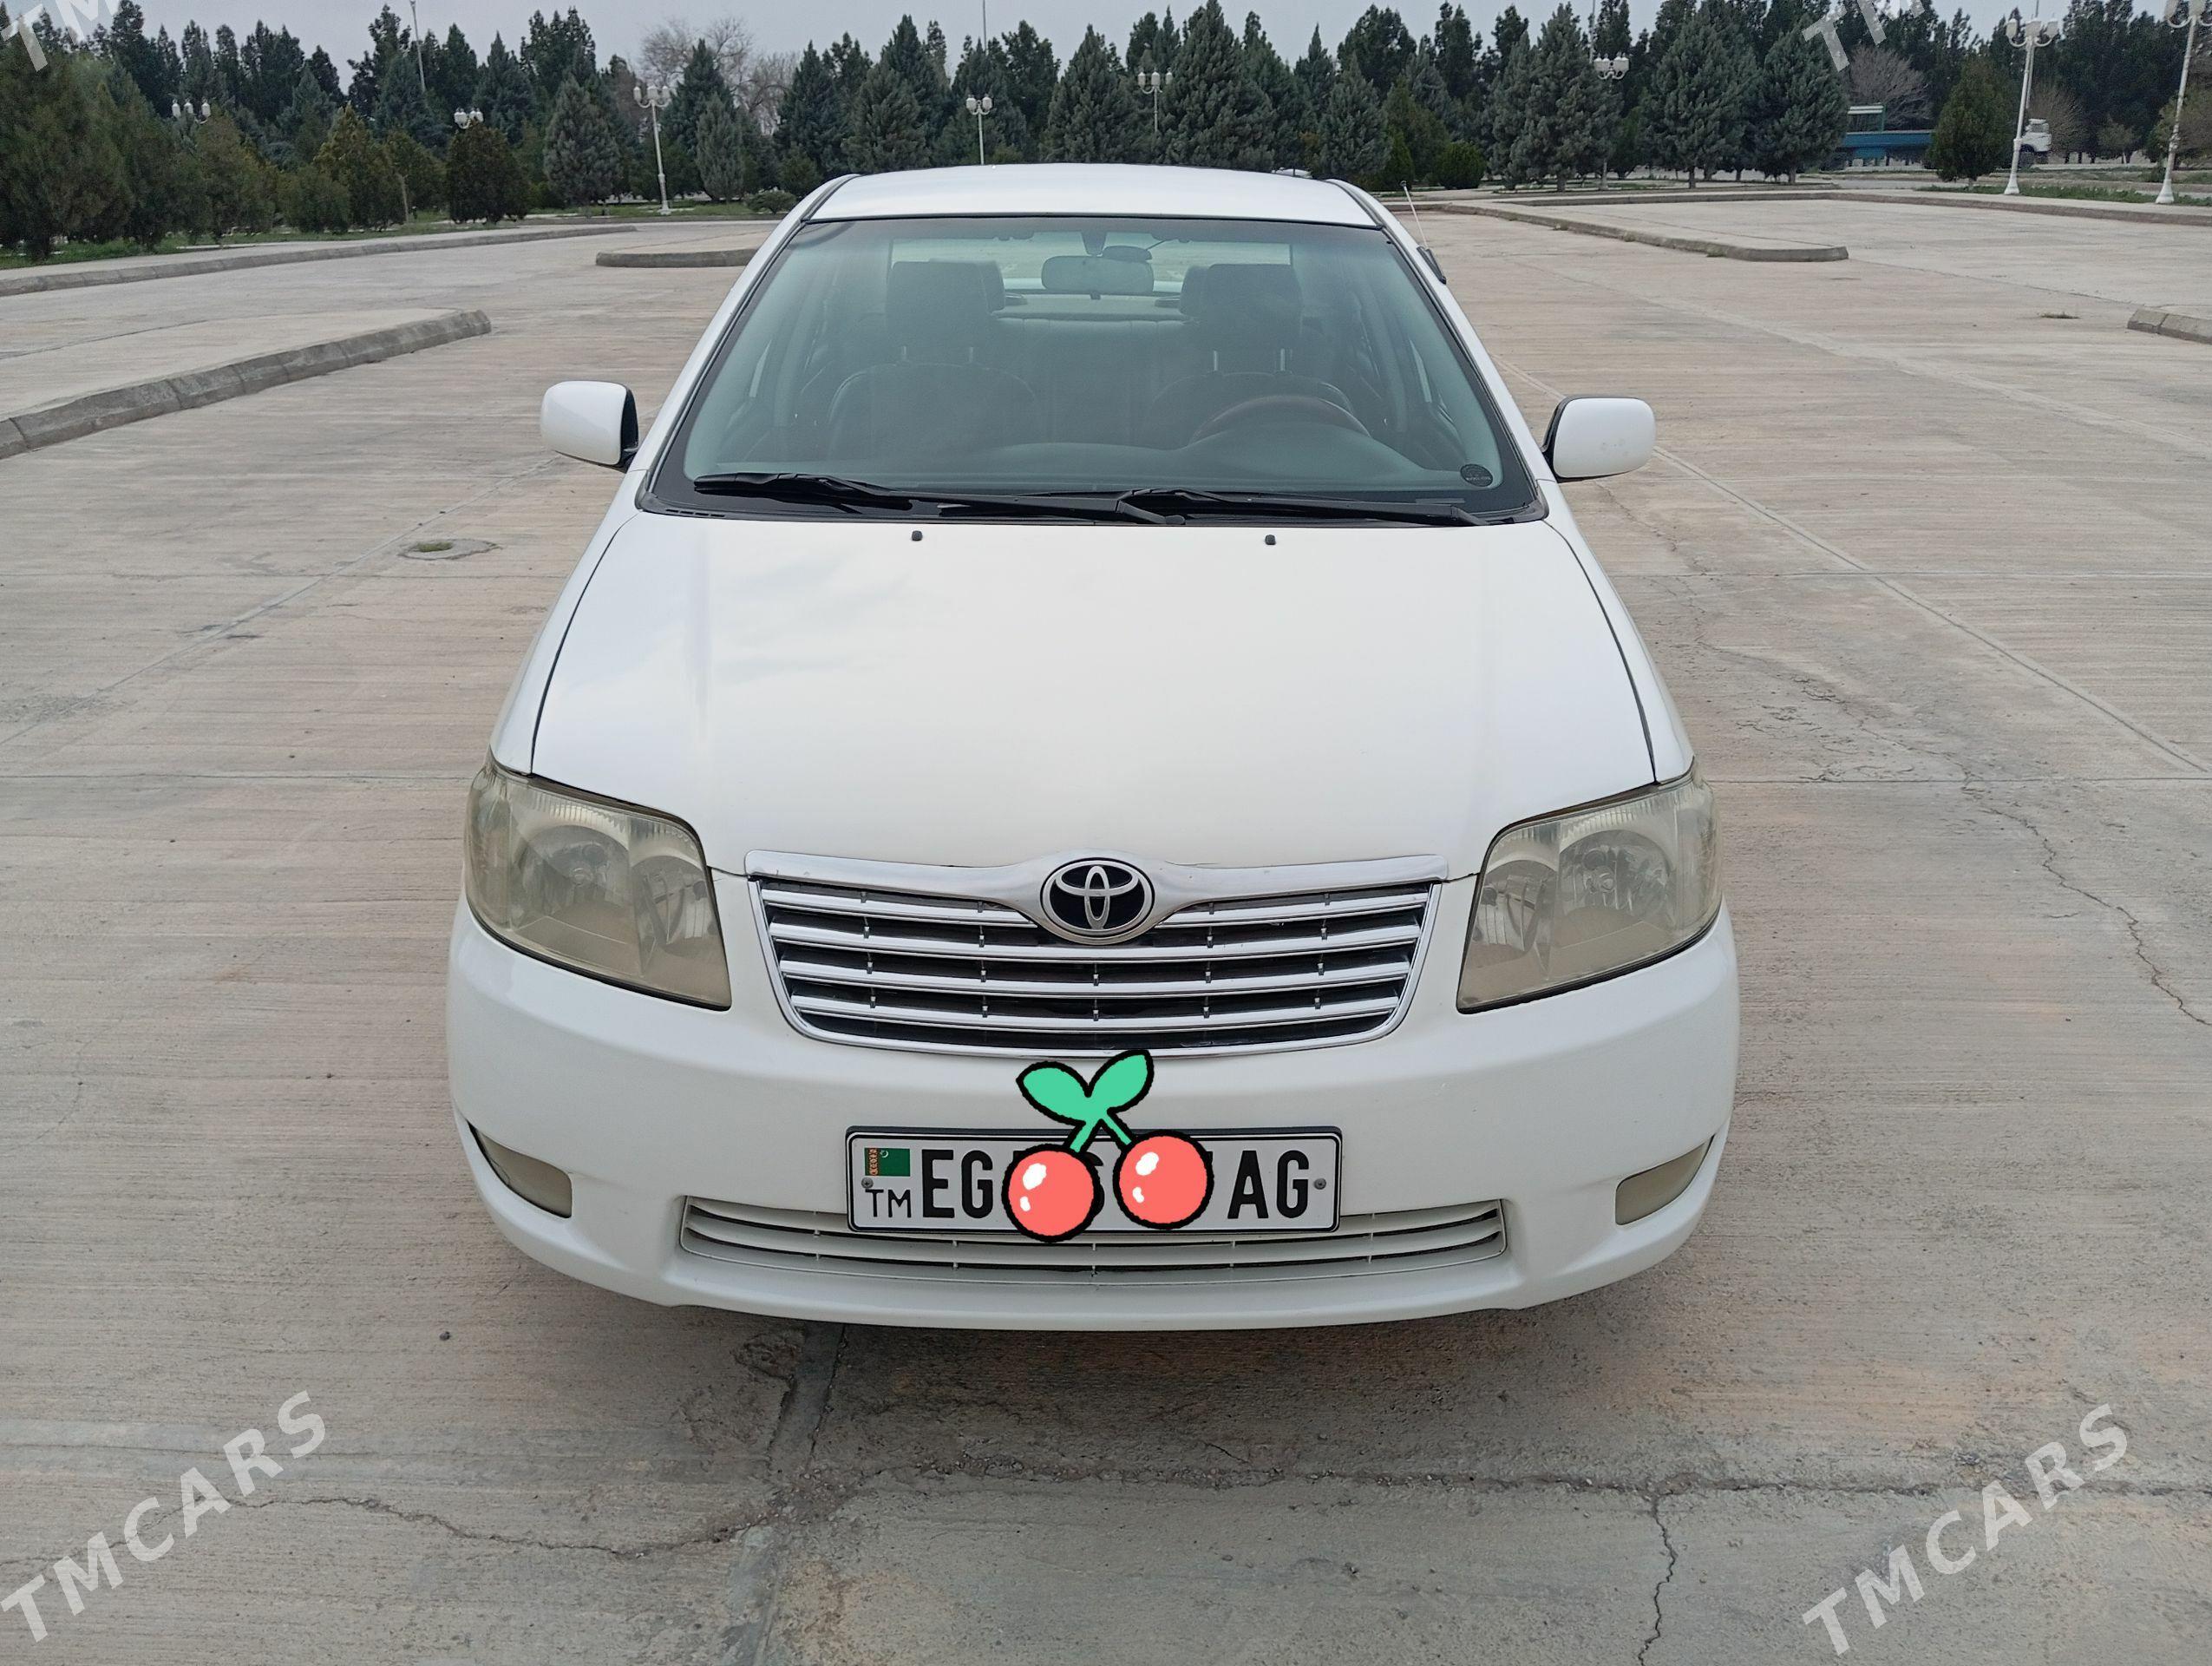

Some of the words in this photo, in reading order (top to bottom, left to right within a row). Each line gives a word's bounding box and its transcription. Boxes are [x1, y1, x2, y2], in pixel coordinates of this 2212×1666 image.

[865, 1189, 912, 1218] TM
[921, 1149, 993, 1219] EG
[1227, 1150, 1310, 1219] AG
